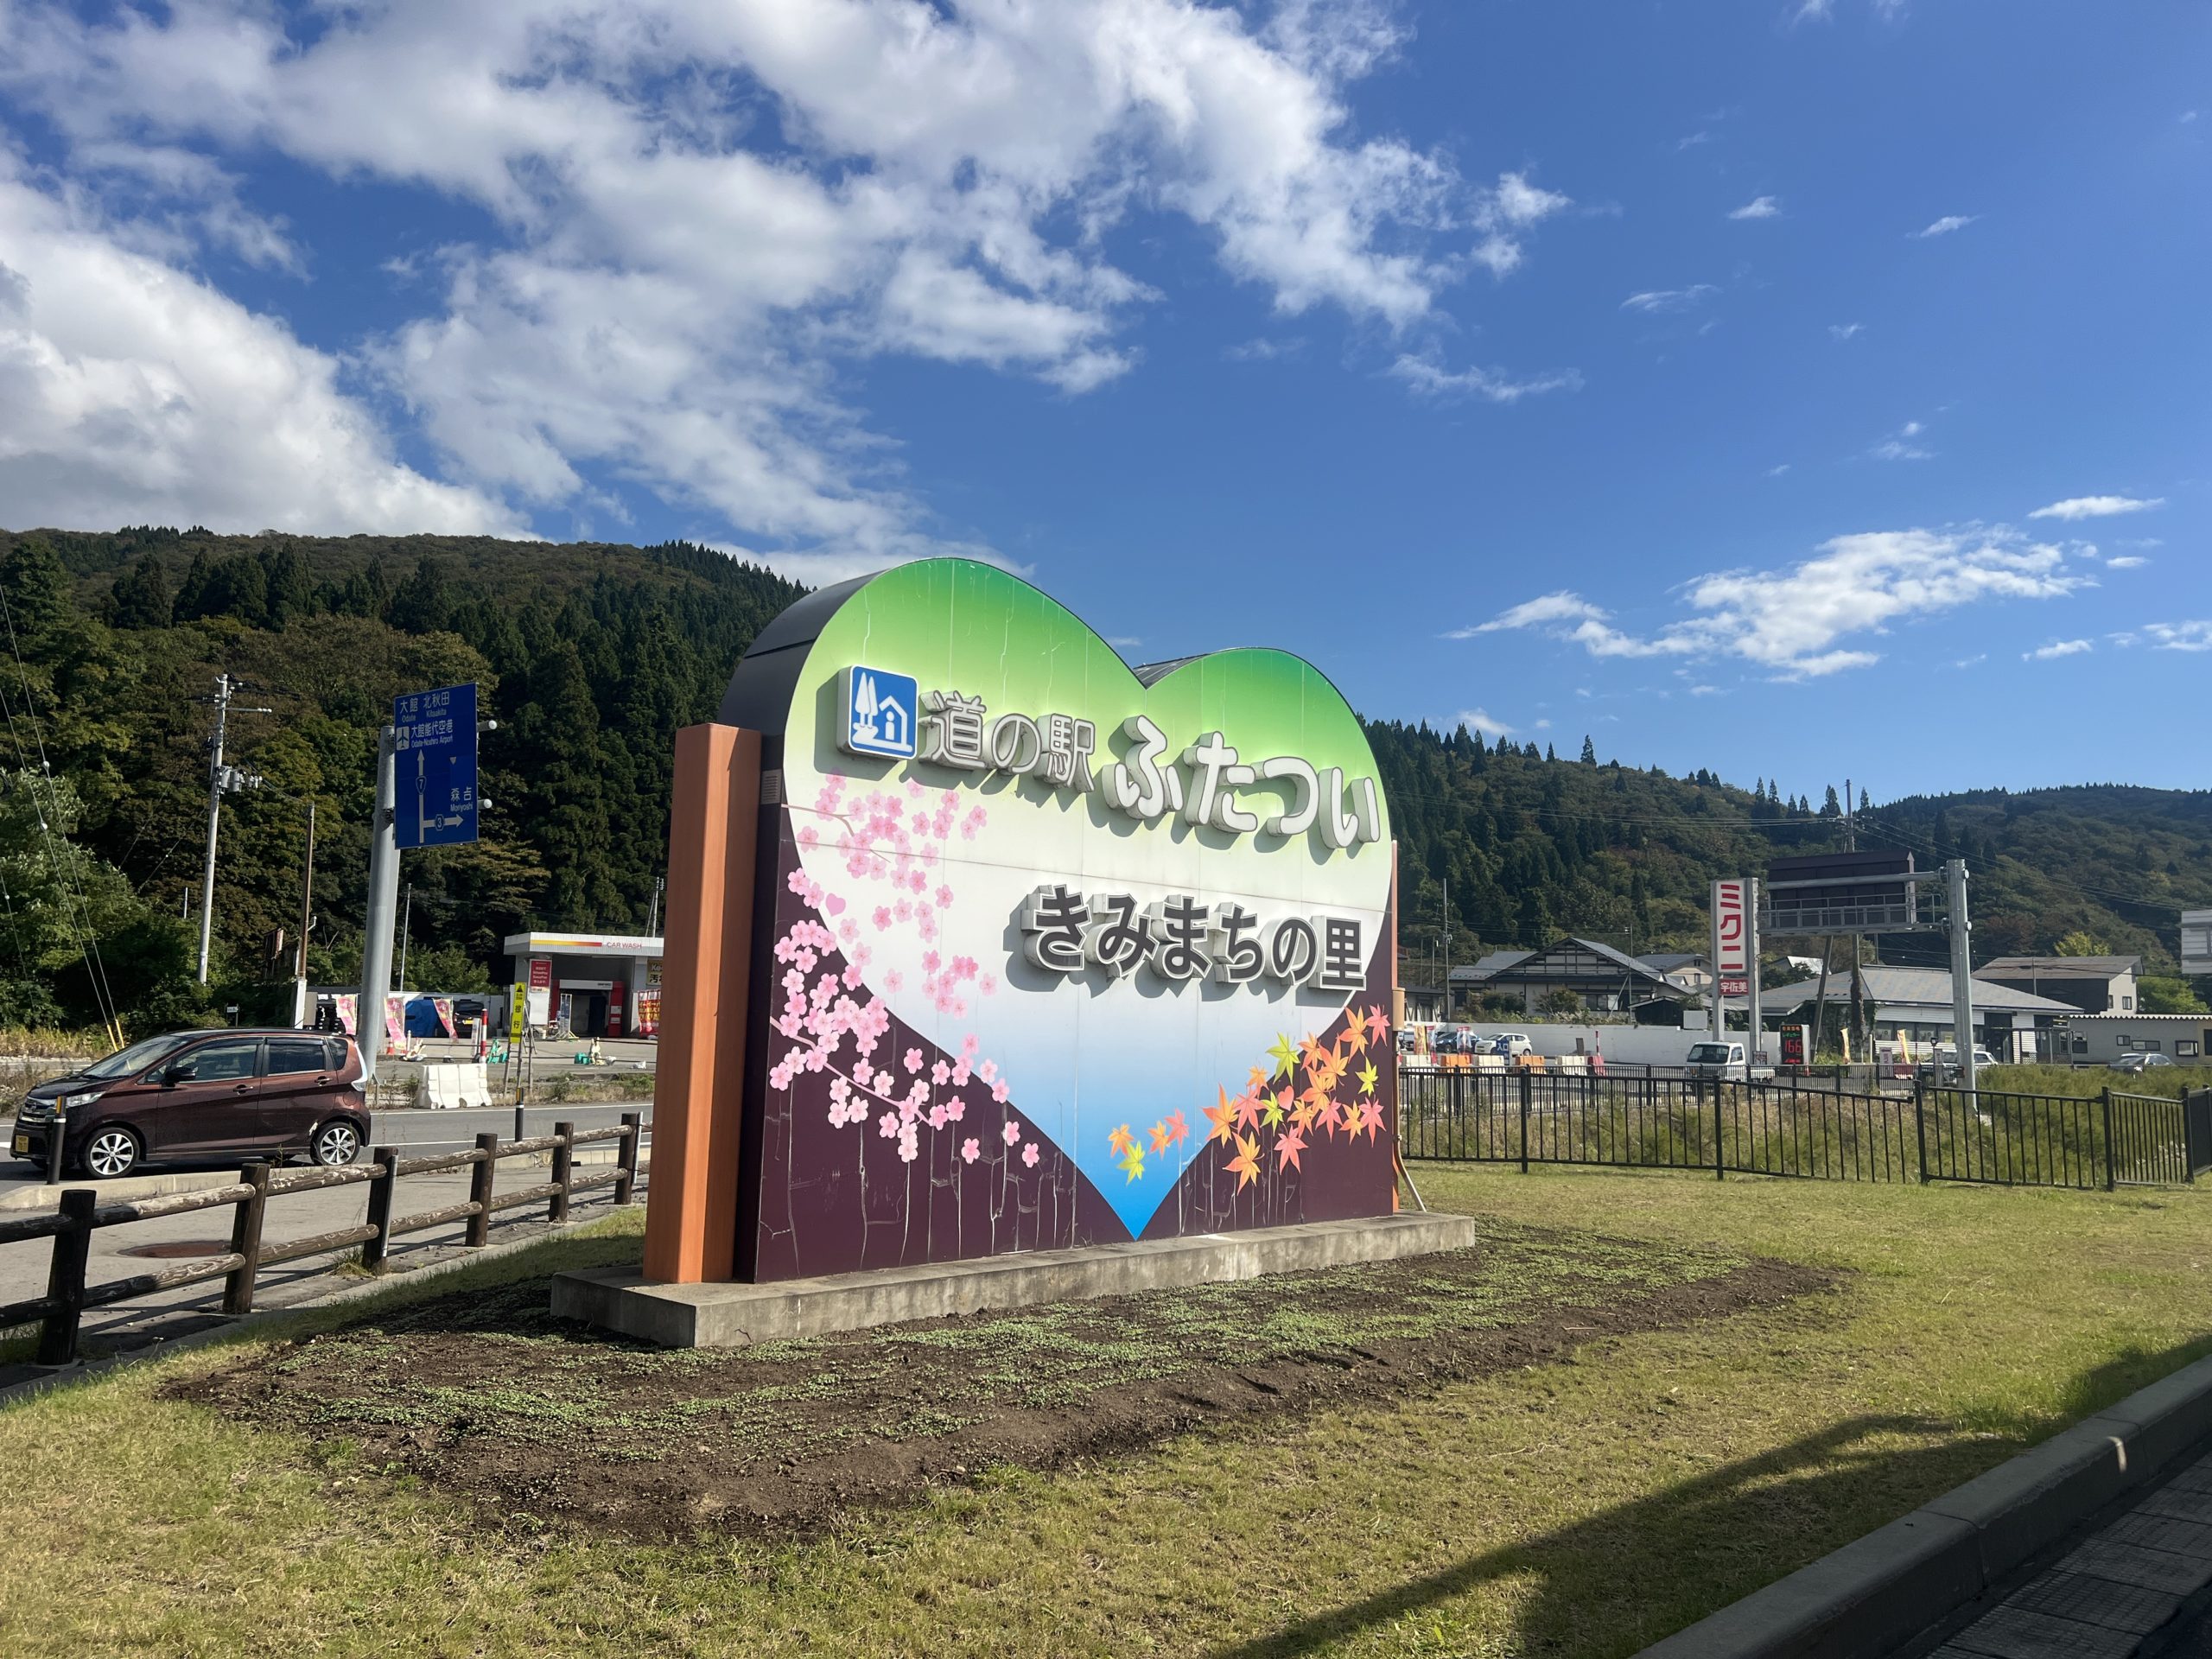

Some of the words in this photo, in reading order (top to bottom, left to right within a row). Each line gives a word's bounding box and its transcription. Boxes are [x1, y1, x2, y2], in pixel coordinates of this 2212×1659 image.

[400, 697, 418, 714] 大館
[423, 691, 449, 709] 北秋田
[410, 719, 453, 739] 大館能代空港
[440, 735, 453, 745] Airport
[918, 690, 1096, 793] 道の駅
[1103, 715, 1381, 849] ふたつい
[450, 802, 474, 812] Moriyoshi
[1720, 884, 1743, 969] ミクニ
[1022, 883, 1367, 992] きみまちの里
[1720, 982, 1747, 993] 宇佐美
[1497, 1042, 1509, 1052] 入口
[1785, 1039, 1802, 1053] 166
